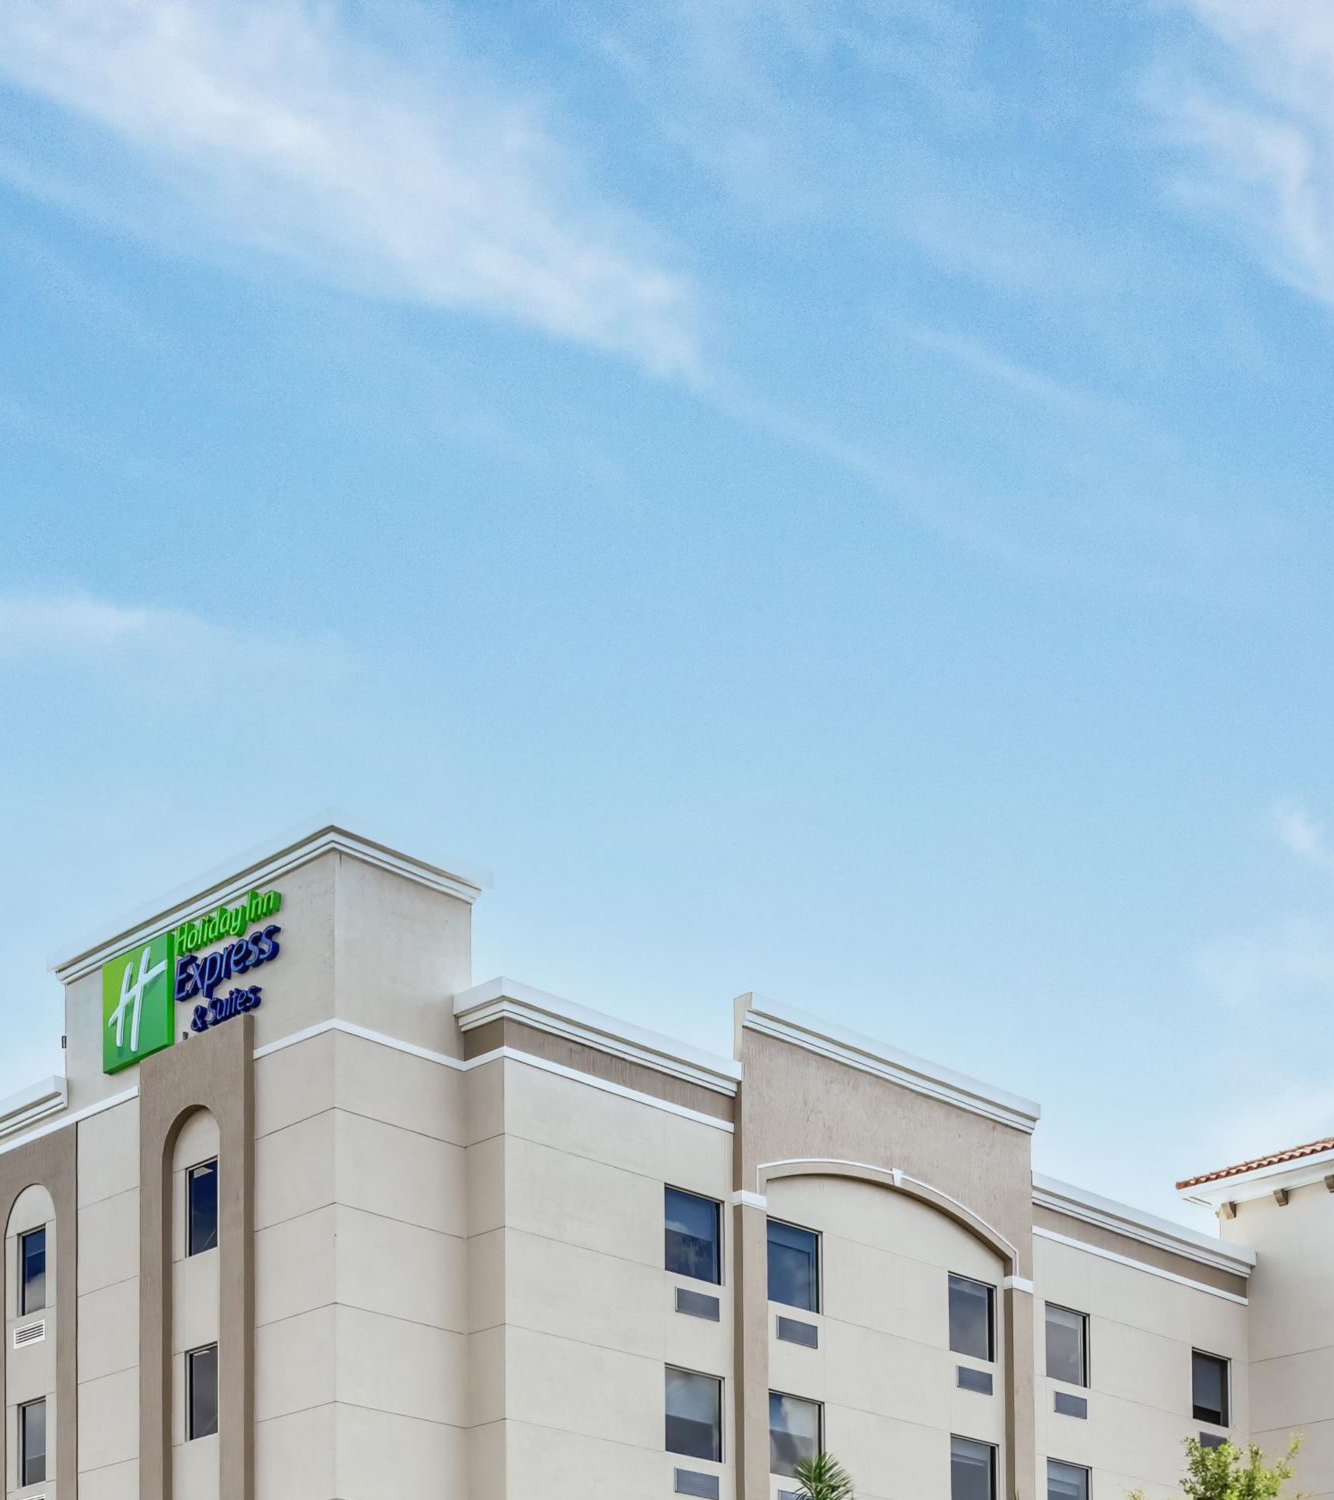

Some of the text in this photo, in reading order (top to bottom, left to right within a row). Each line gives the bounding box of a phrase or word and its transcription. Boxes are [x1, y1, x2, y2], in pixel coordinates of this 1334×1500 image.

[175, 889, 279, 955] Holiday Inn
[174, 925, 279, 1001] Express
[108, 946, 167, 1052] H
[191, 985, 261, 1032] & Suites
